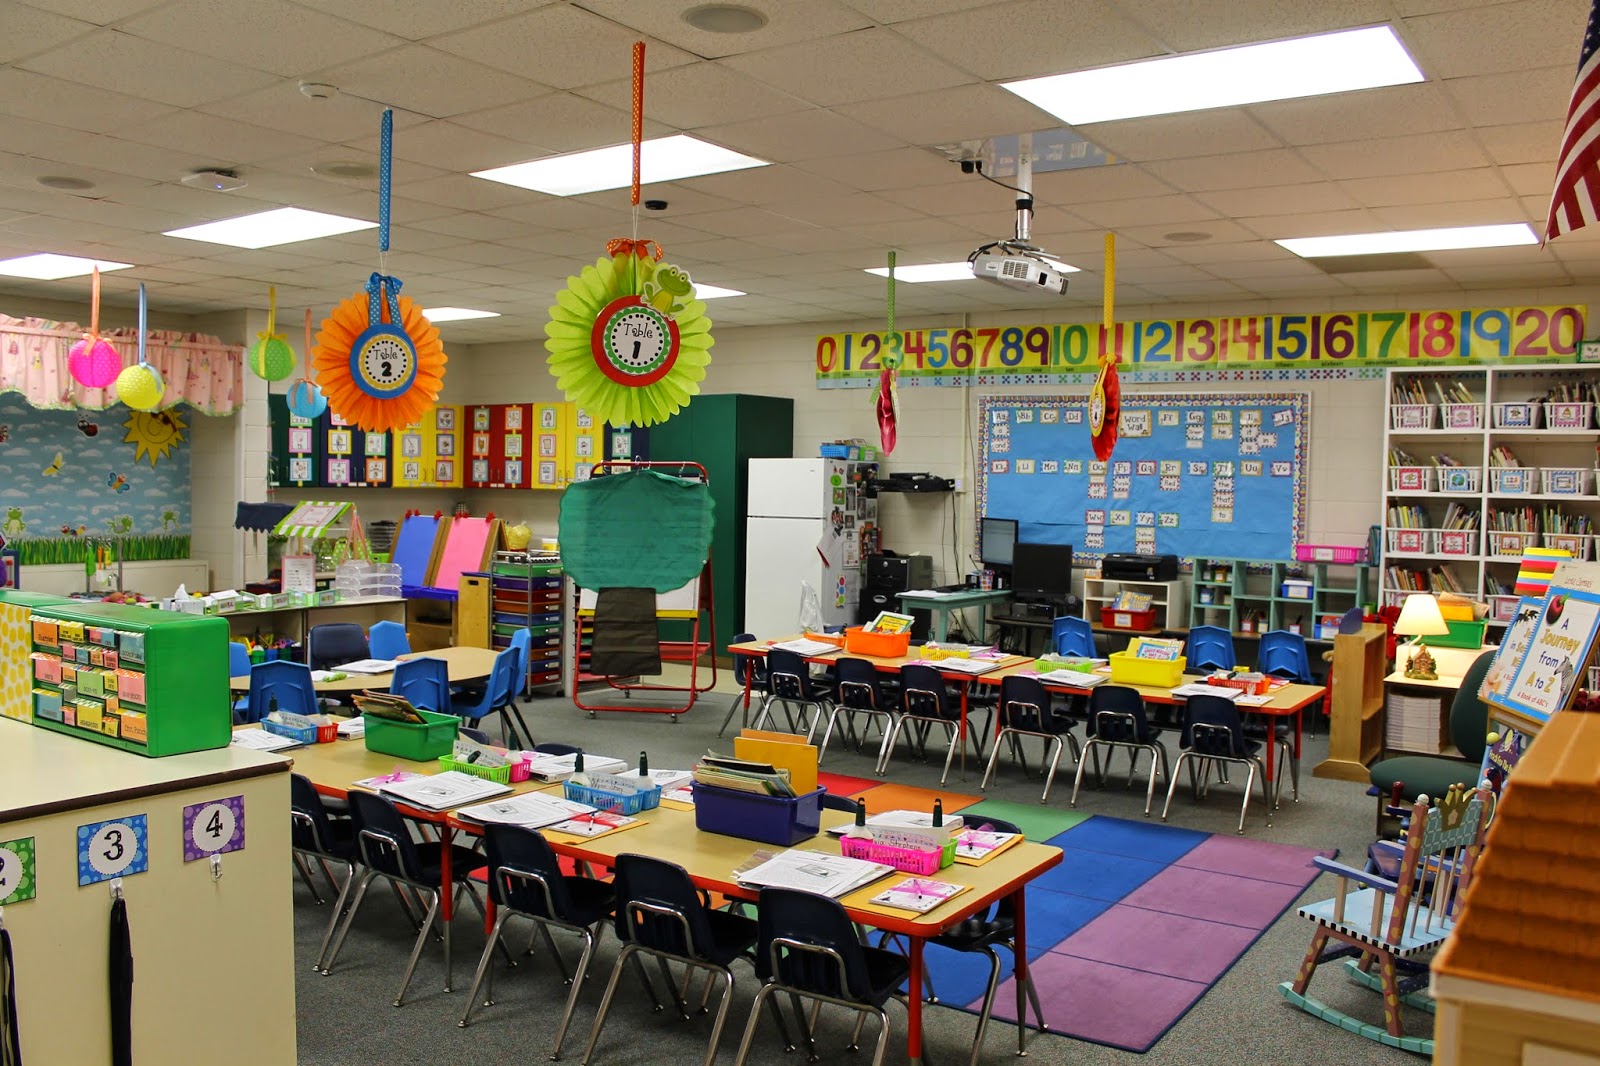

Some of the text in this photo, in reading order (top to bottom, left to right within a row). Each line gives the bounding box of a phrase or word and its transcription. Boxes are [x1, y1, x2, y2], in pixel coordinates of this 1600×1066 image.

[624, 322, 653, 338] Table
[817, 307, 1584, 372] 0 1 2 3 4 5 6 7 8 9 10 11 12 13 14 15 16 17 18 19 20
[373, 346, 398, 360] Table
[632, 340, 642, 360] 1
[381, 361, 392, 376] 2
[1020, 412, 1030, 420] Bb
[1044, 412, 1054, 420] Cc
[1124, 414, 1146, 423] Word
[1163, 414, 1173, 422] Ff
[1189, 412, 1201, 422] Gg
[1216, 412, 1228, 420] Hh
[996, 462, 1004, 470] Kk
[1118, 464, 1128, 472] Pp
[1140, 464, 1152, 472] Qq
[1165, 464, 1176, 472] Rr
[1115, 513, 1126, 521] Xx
[1140, 514, 1151, 524] Yy
[1164, 516, 1174, 524] Zz
[1560, 618, 1570, 630] A
[1540, 628, 1581, 656] Journey
[1538, 650, 1559, 668] from
[1526, 672, 1556, 693] A to Z
[206, 810, 224, 838] 4
[103, 830, 124, 861] 3
